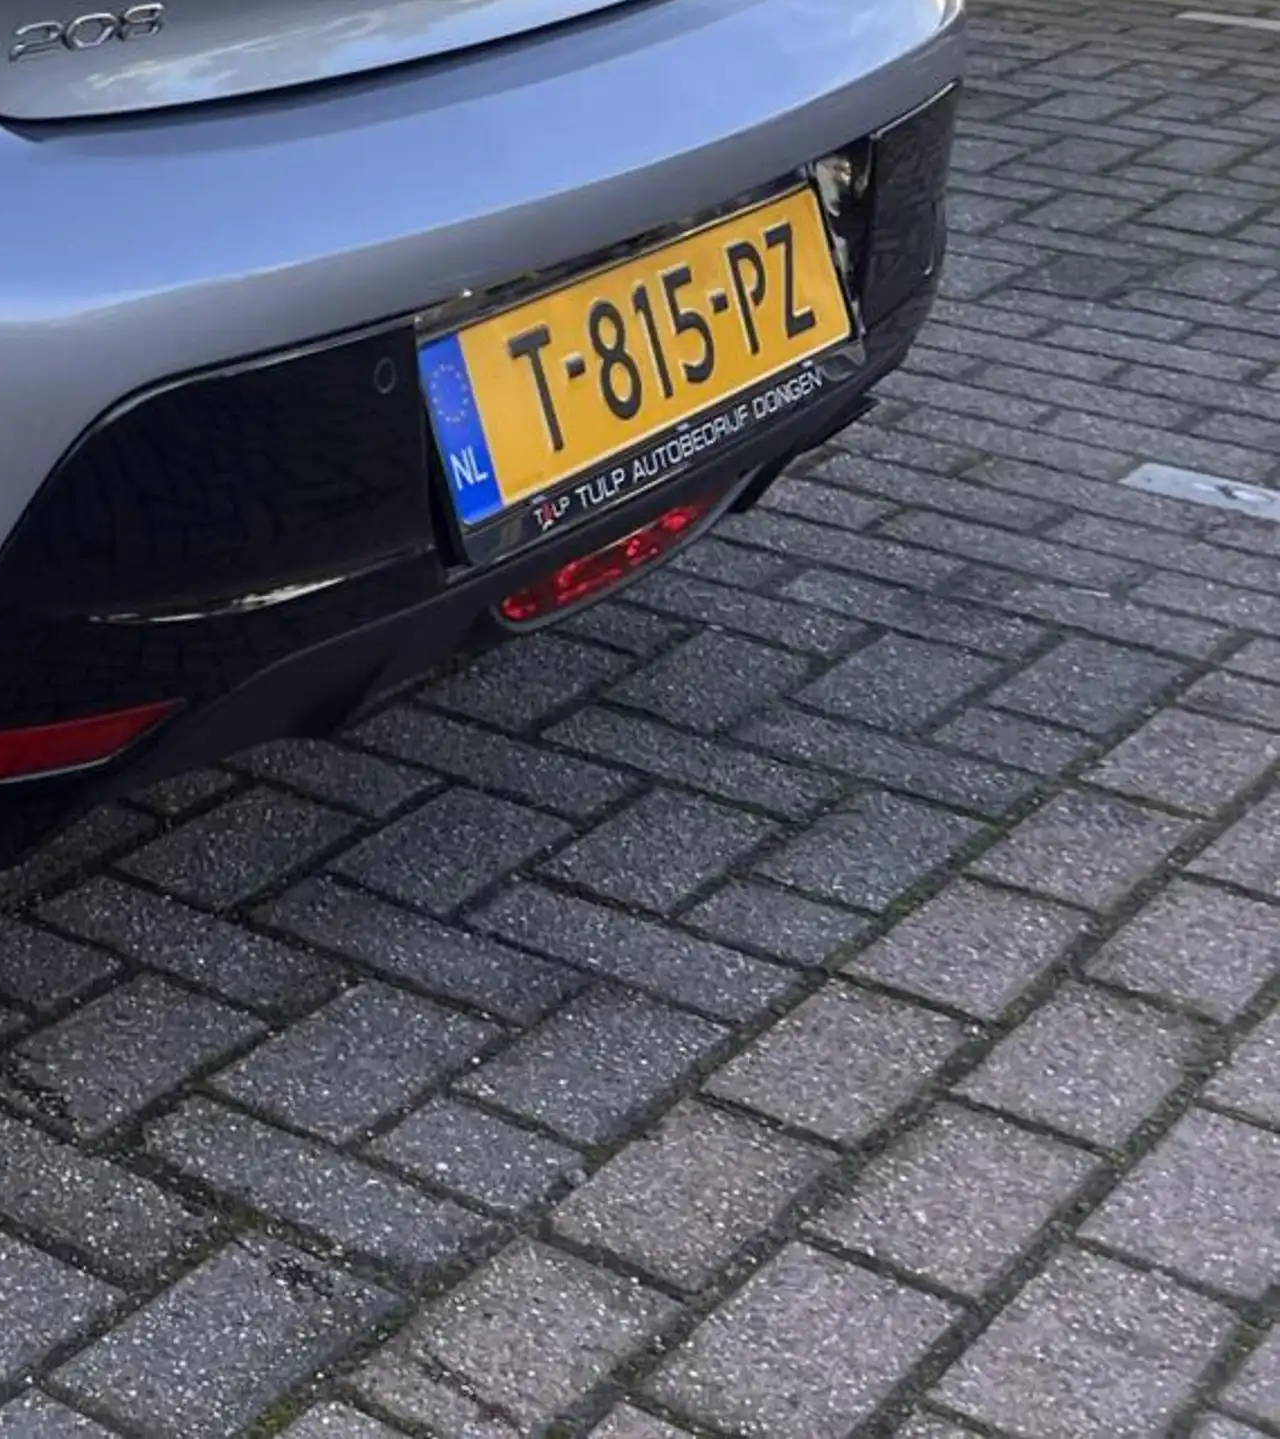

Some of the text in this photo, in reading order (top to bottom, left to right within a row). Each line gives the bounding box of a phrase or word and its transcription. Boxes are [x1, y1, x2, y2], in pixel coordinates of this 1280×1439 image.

[8, 2, 165, 63] 208
[507, 222, 816, 452] T-815-PZ
[448, 444, 489, 491] NL
[573, 467, 626, 509] TULP
[632, 406, 749, 483] AUTOBEDRIJF
[751, 368, 823, 419] DONGEN
